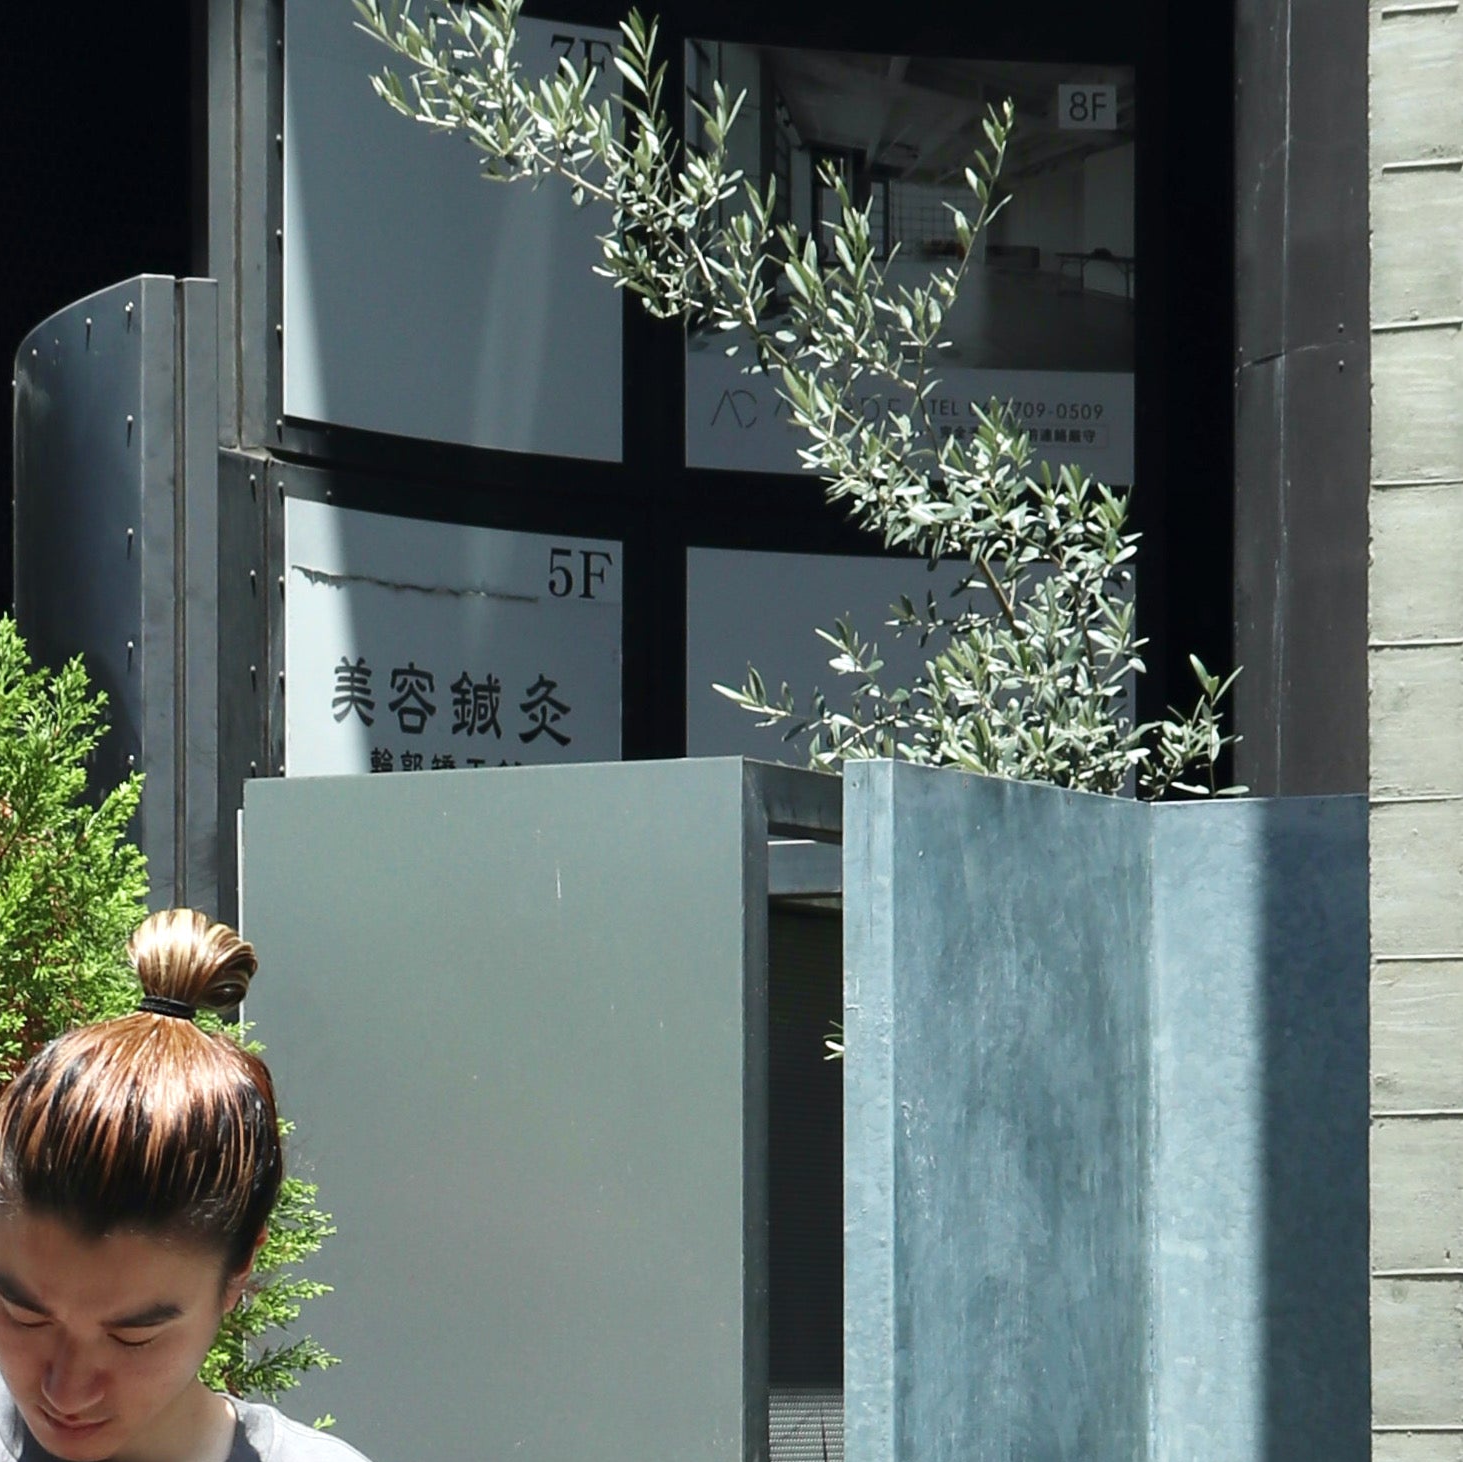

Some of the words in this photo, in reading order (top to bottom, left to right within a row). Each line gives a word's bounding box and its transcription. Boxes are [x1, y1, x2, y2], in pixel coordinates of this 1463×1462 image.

[550, 33, 614, 90] 7F
[1069, 91, 1108, 122] 8F
[930, 401, 959, 416] TEL
[548, 547, 613, 599] 5F
[332, 656, 571, 746] 美容鍼灸
